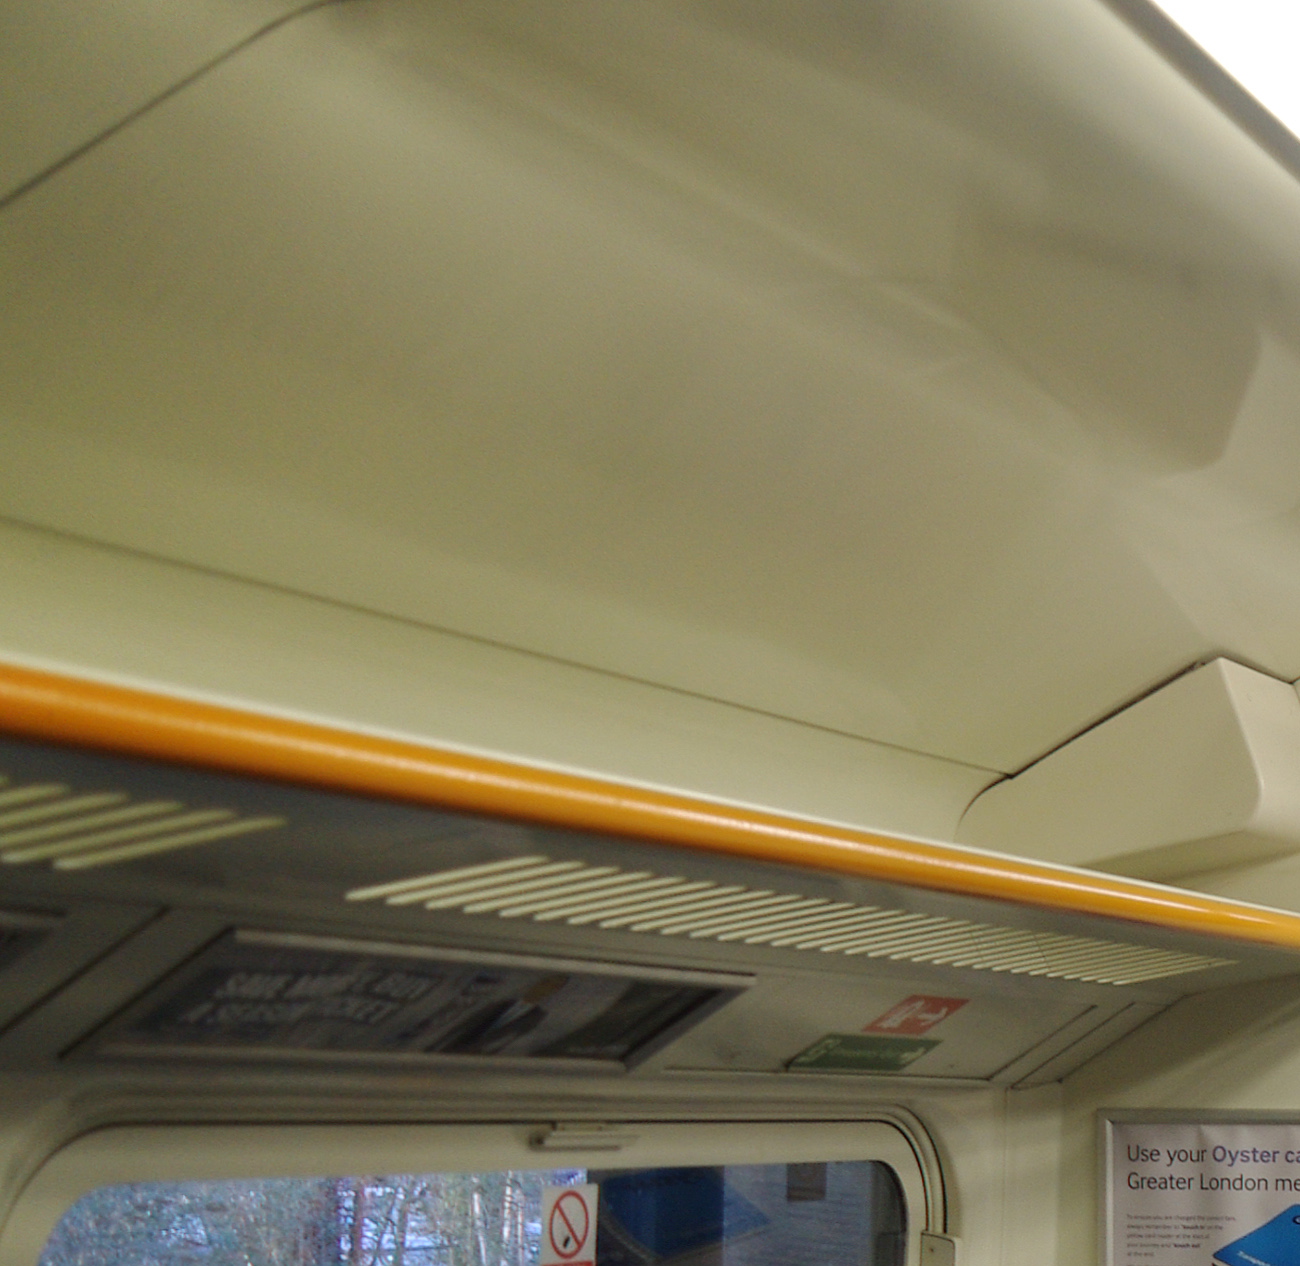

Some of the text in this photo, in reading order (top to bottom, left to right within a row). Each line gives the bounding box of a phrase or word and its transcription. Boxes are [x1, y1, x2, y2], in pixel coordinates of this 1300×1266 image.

[1127, 1144, 1161, 1163] Use
[1166, 1149, 1207, 1167] your
[1212, 1145, 1279, 1167] Oyster
[1127, 1172, 1195, 1190] Greater
[1200, 1173, 1269, 1191] London
